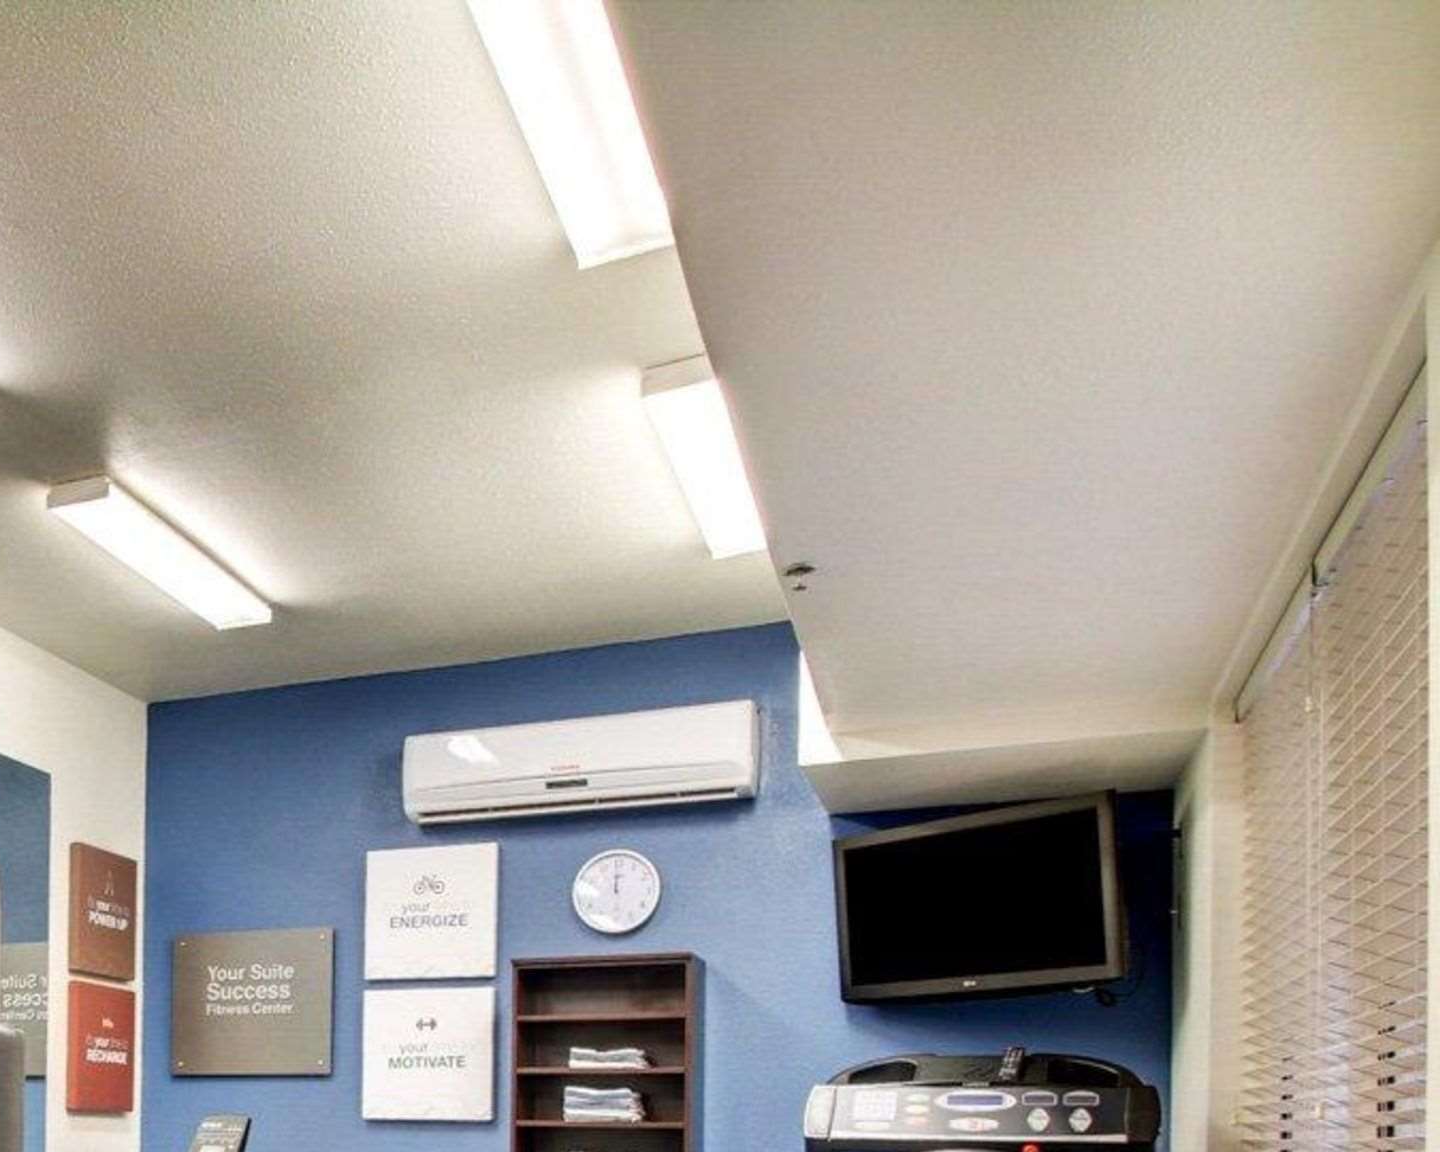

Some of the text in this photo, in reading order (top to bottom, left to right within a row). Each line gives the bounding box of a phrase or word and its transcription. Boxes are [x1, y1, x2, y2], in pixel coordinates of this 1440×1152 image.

[389, 913, 470, 928] ENERGIZE
[206, 963, 295, 981] Your Suite
[206, 982, 291, 1001] Success
[206, 1001, 294, 1016] Fitness Center
[388, 1055, 467, 1069] MOTIVATE
